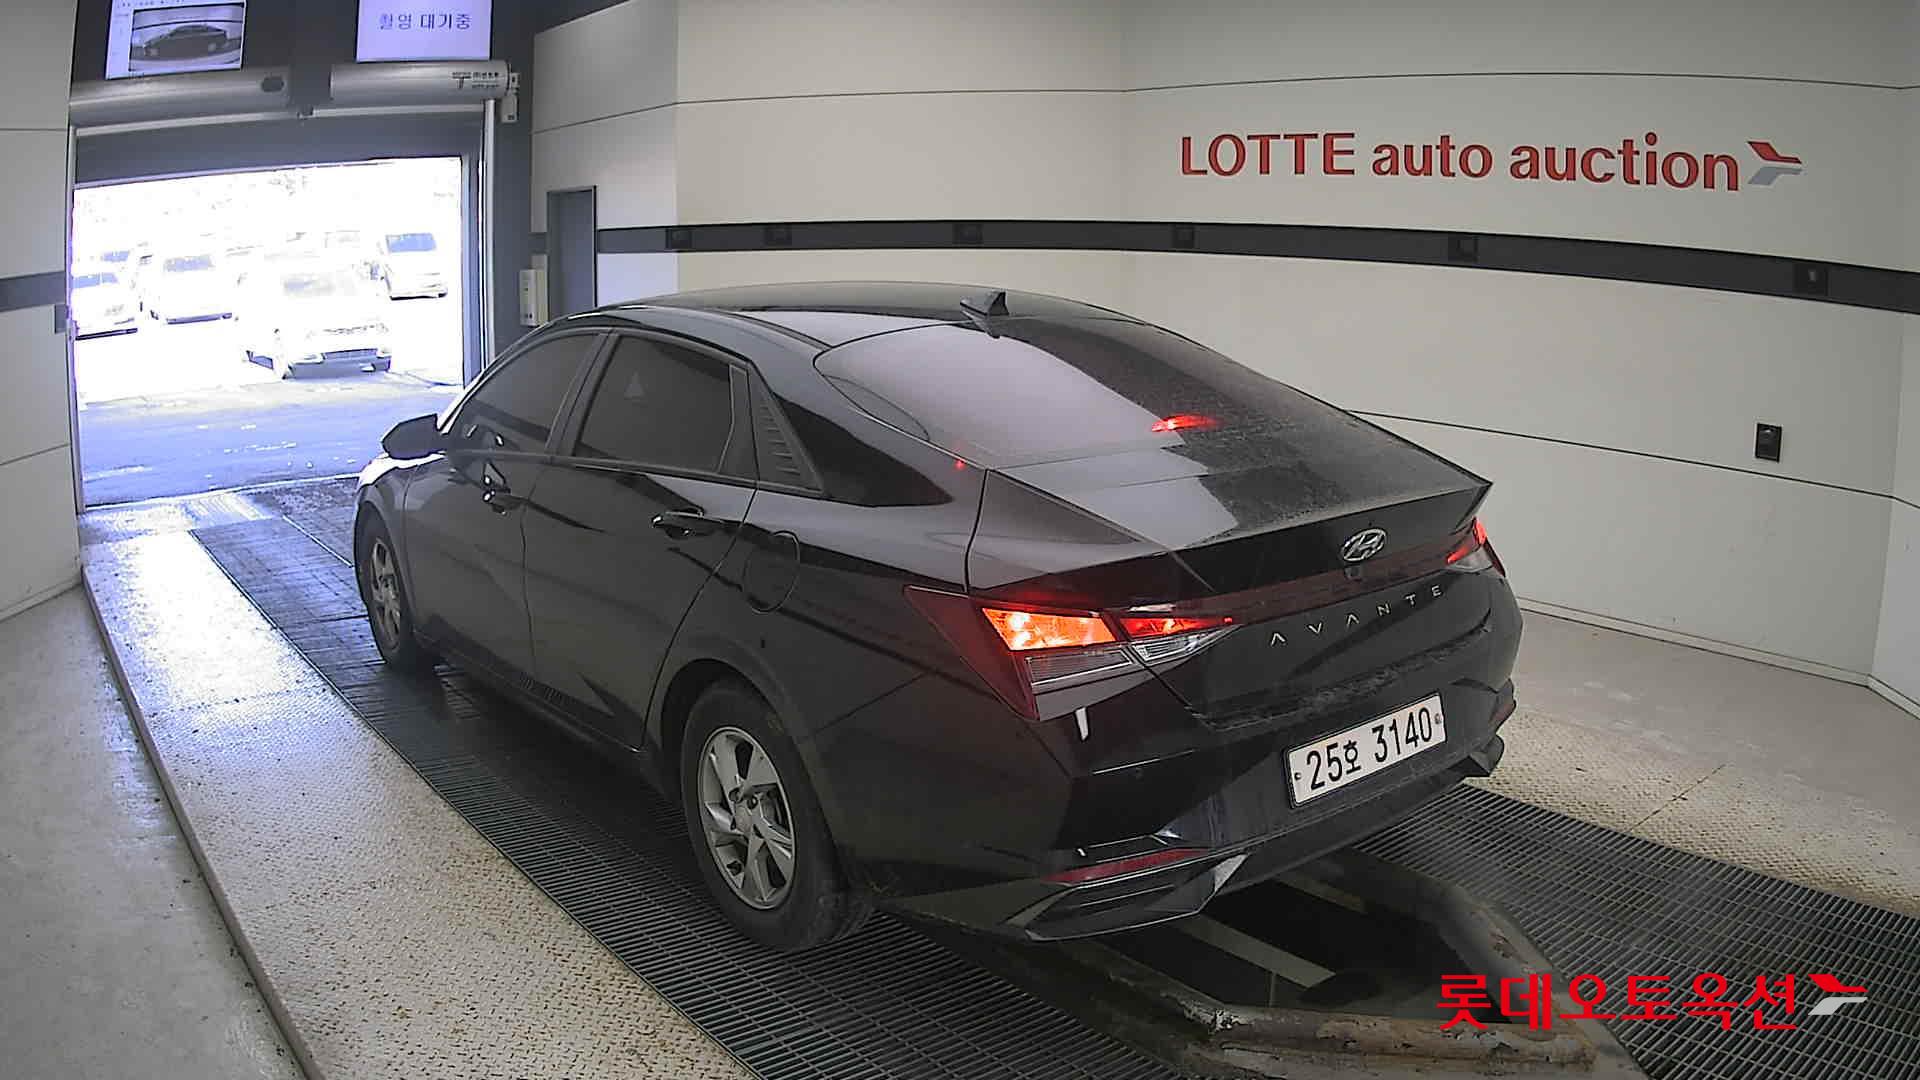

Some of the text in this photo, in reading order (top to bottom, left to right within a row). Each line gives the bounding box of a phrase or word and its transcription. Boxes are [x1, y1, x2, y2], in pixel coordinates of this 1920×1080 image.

[420, 13, 472, 30] 대기중
[1181, 131, 1740, 191] LOTTE auto auction
[1270, 585, 1442, 646] AVANTE
[1306, 707, 1432, 791] 25호 3140
